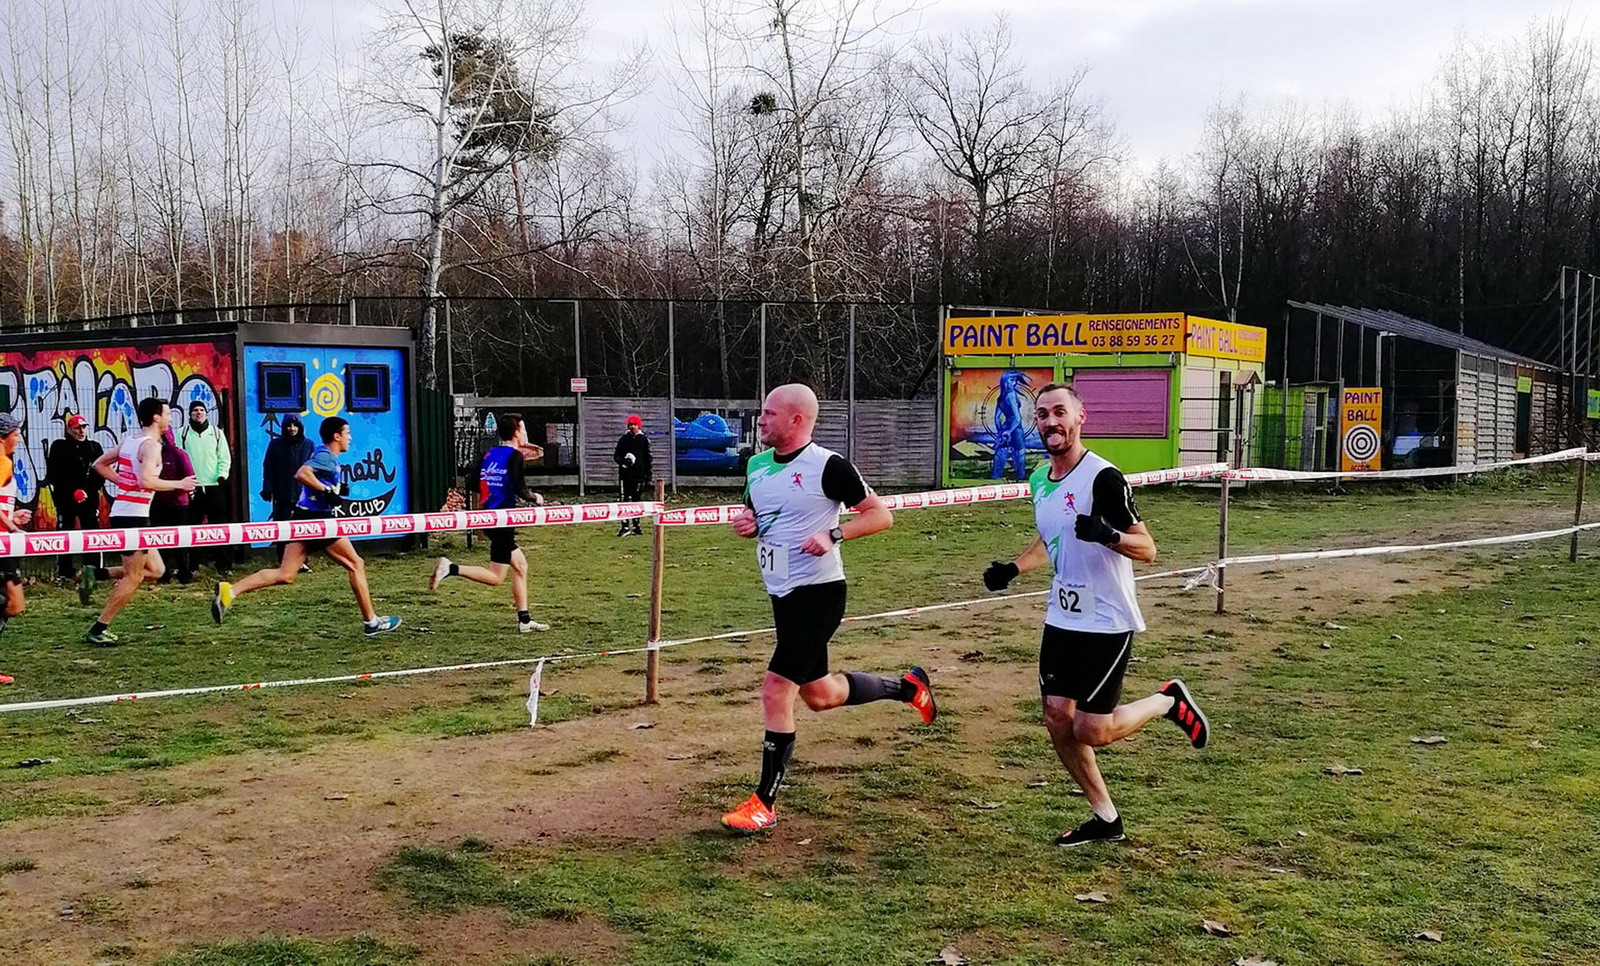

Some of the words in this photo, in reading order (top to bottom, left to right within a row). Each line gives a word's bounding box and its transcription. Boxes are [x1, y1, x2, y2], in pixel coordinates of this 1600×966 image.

[1089, 317, 1180, 331] RENSEIGNEMENTS
[949, 323, 1019, 348] PAINT
[1026, 322, 1088, 346] BALL
[1092, 335, 1105, 347] 03
[1109, 335, 1123, 346] 88
[1126, 335, 1140, 346] 59
[1144, 335, 1158, 346] 36
[1162, 334, 1175, 346] 27
[1344, 392, 1381, 404] PAINT
[1347, 409, 1378, 421] BALL
[349, 499, 386, 517] CLUB
[87, 533, 121, 547] DNA
[195, 527, 227, 541] DNA
[294, 522, 323, 536] DNA
[385, 517, 412, 530] DNA
[470, 513, 494, 525] DNA
[549, 508, 571, 519] DNA
[760, 546, 774, 571] 61
[1058, 587, 1082, 613] 62
